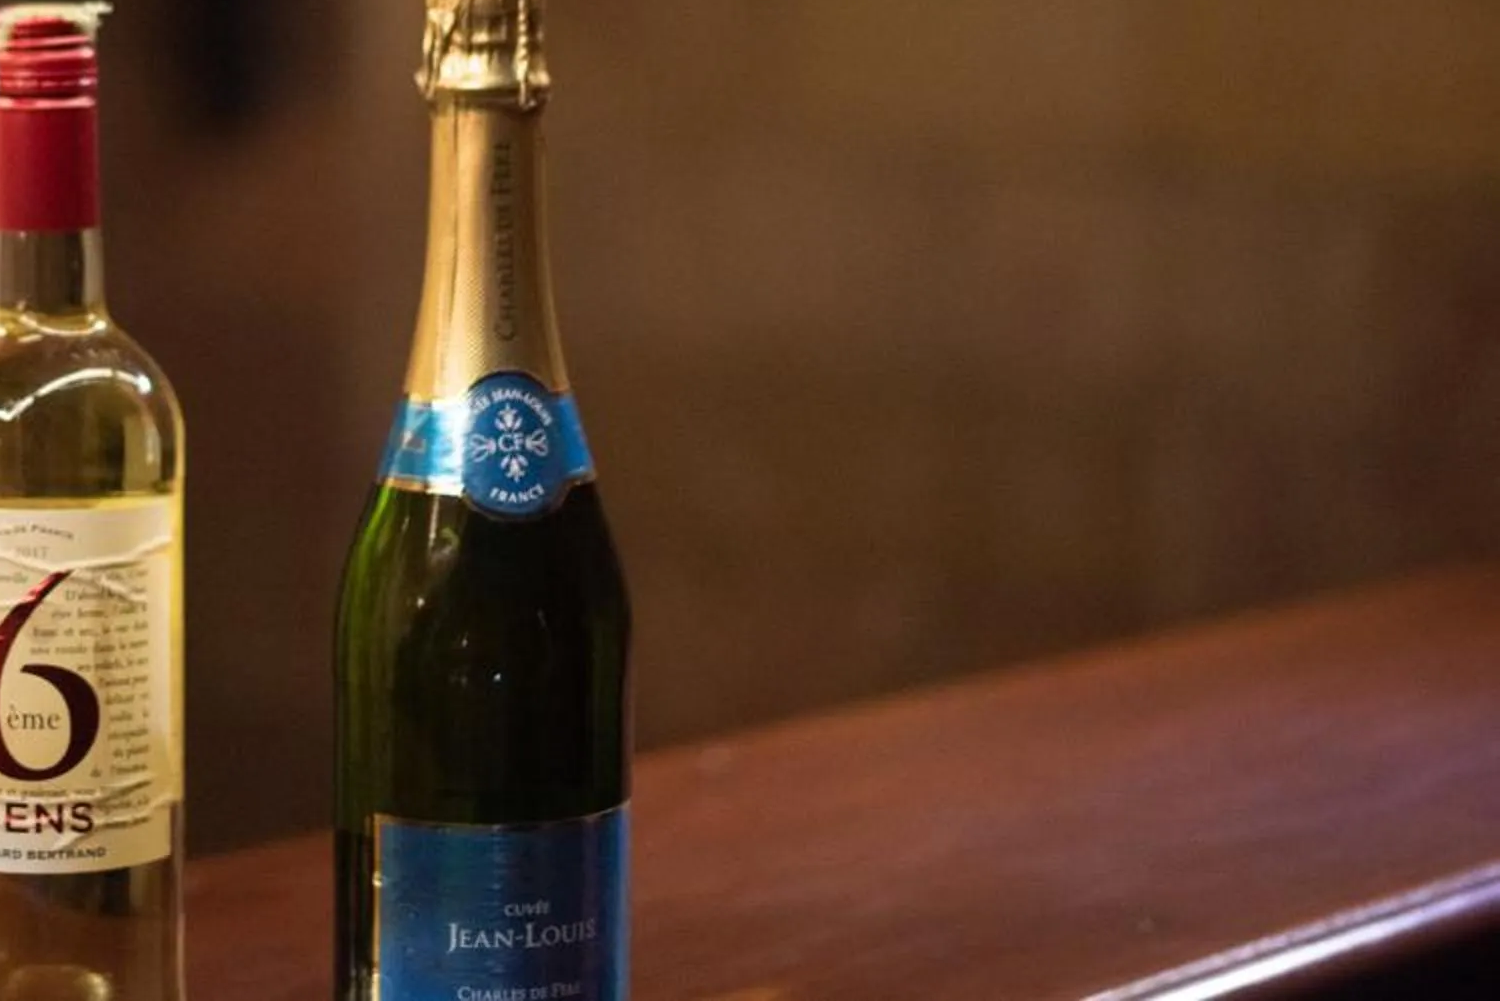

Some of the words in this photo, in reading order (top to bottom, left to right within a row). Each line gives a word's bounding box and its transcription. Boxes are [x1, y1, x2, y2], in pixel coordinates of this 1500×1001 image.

[6, 703, 62, 731] ème
[26, 846, 107, 861] BERTRAND
[448, 918, 596, 953] JEAN-LOUIS
